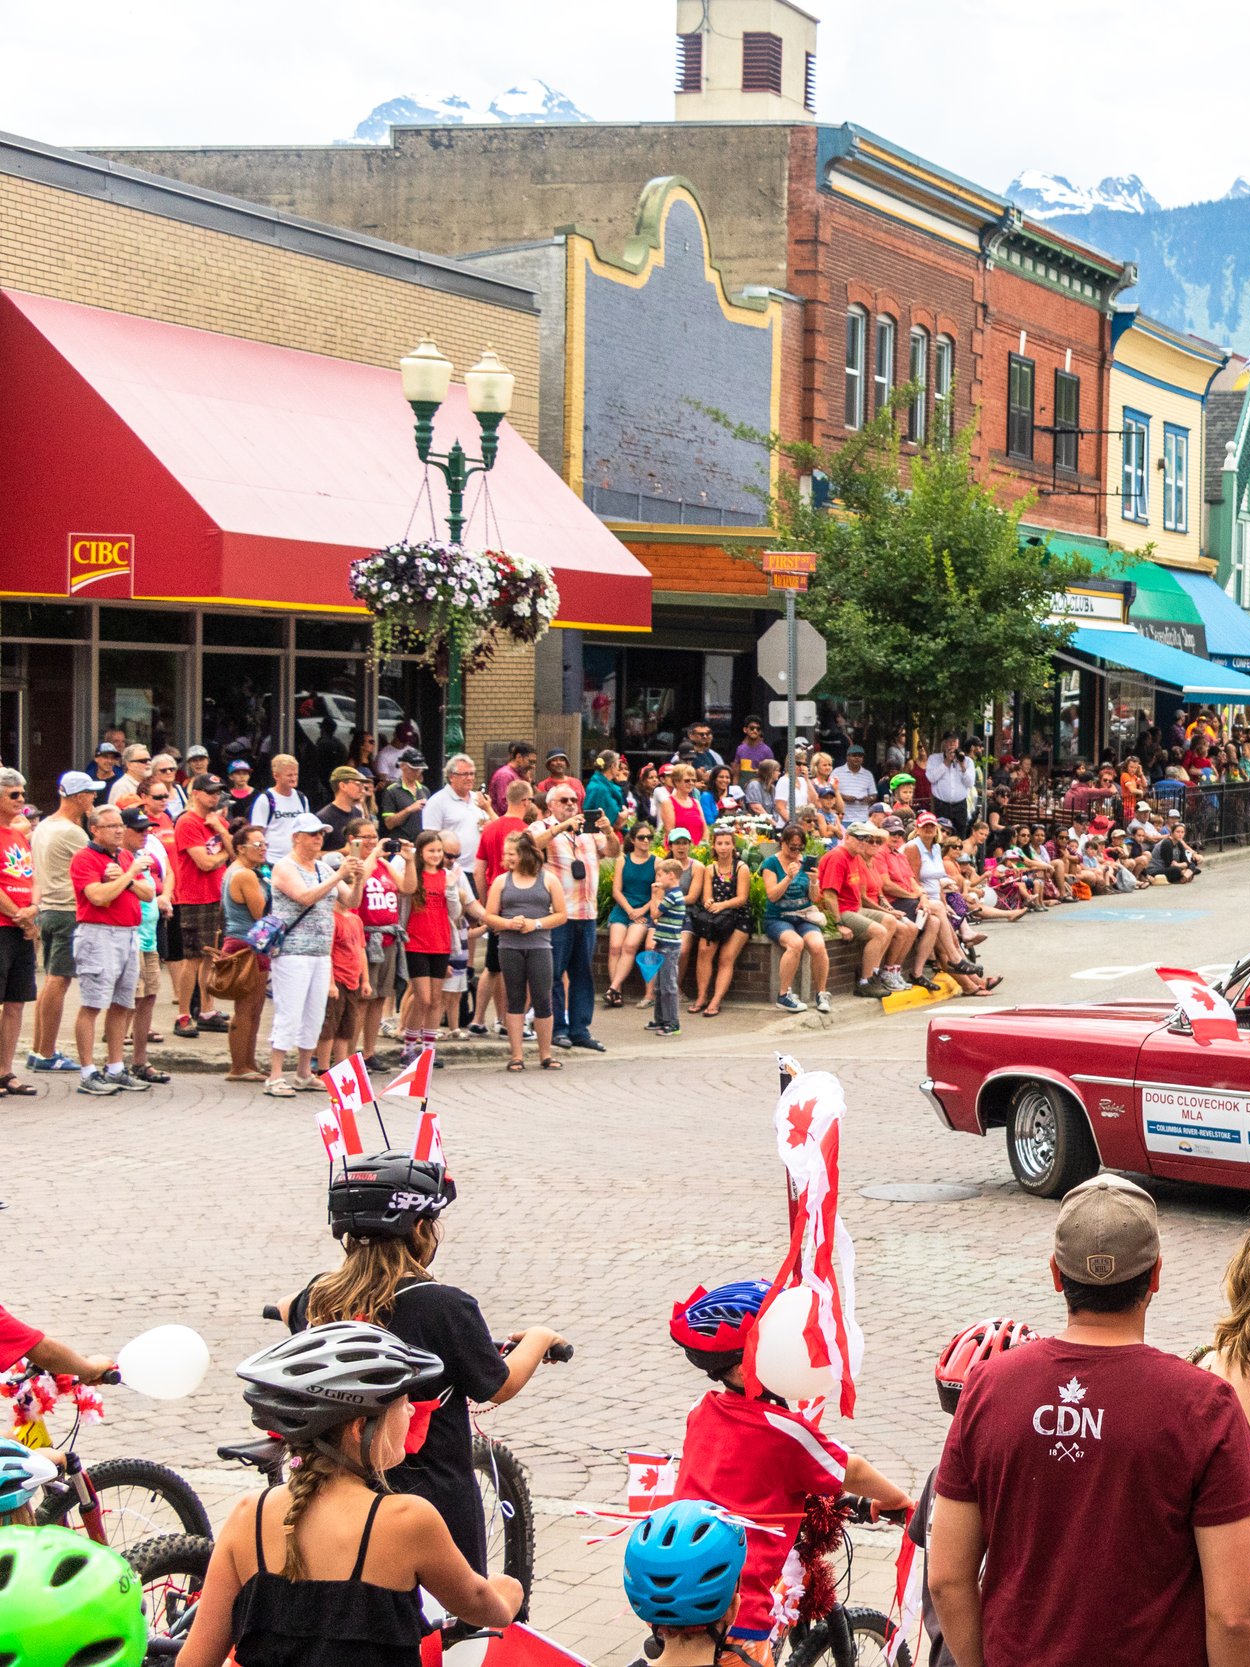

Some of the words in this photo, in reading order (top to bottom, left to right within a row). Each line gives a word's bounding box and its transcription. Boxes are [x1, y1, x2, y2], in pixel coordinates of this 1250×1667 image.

[73, 541, 129, 566] CIBC
[768, 555, 799, 569] FIRST
[366, 892, 397, 910] me
[1145, 1092, 1174, 1105] DOUG
[1177, 1096, 1240, 1112] CLOVECHOK
[1181, 1109, 1203, 1121] MLA
[1156, 1124, 1183, 1134] COLUMBIA
[1183, 1127, 1232, 1139] RIVER-REVELSTOKE
[389, 1192, 434, 1211] SPY
[324, 1389, 363, 1404] GIRO
[1033, 1404, 1104, 1440] CDN
